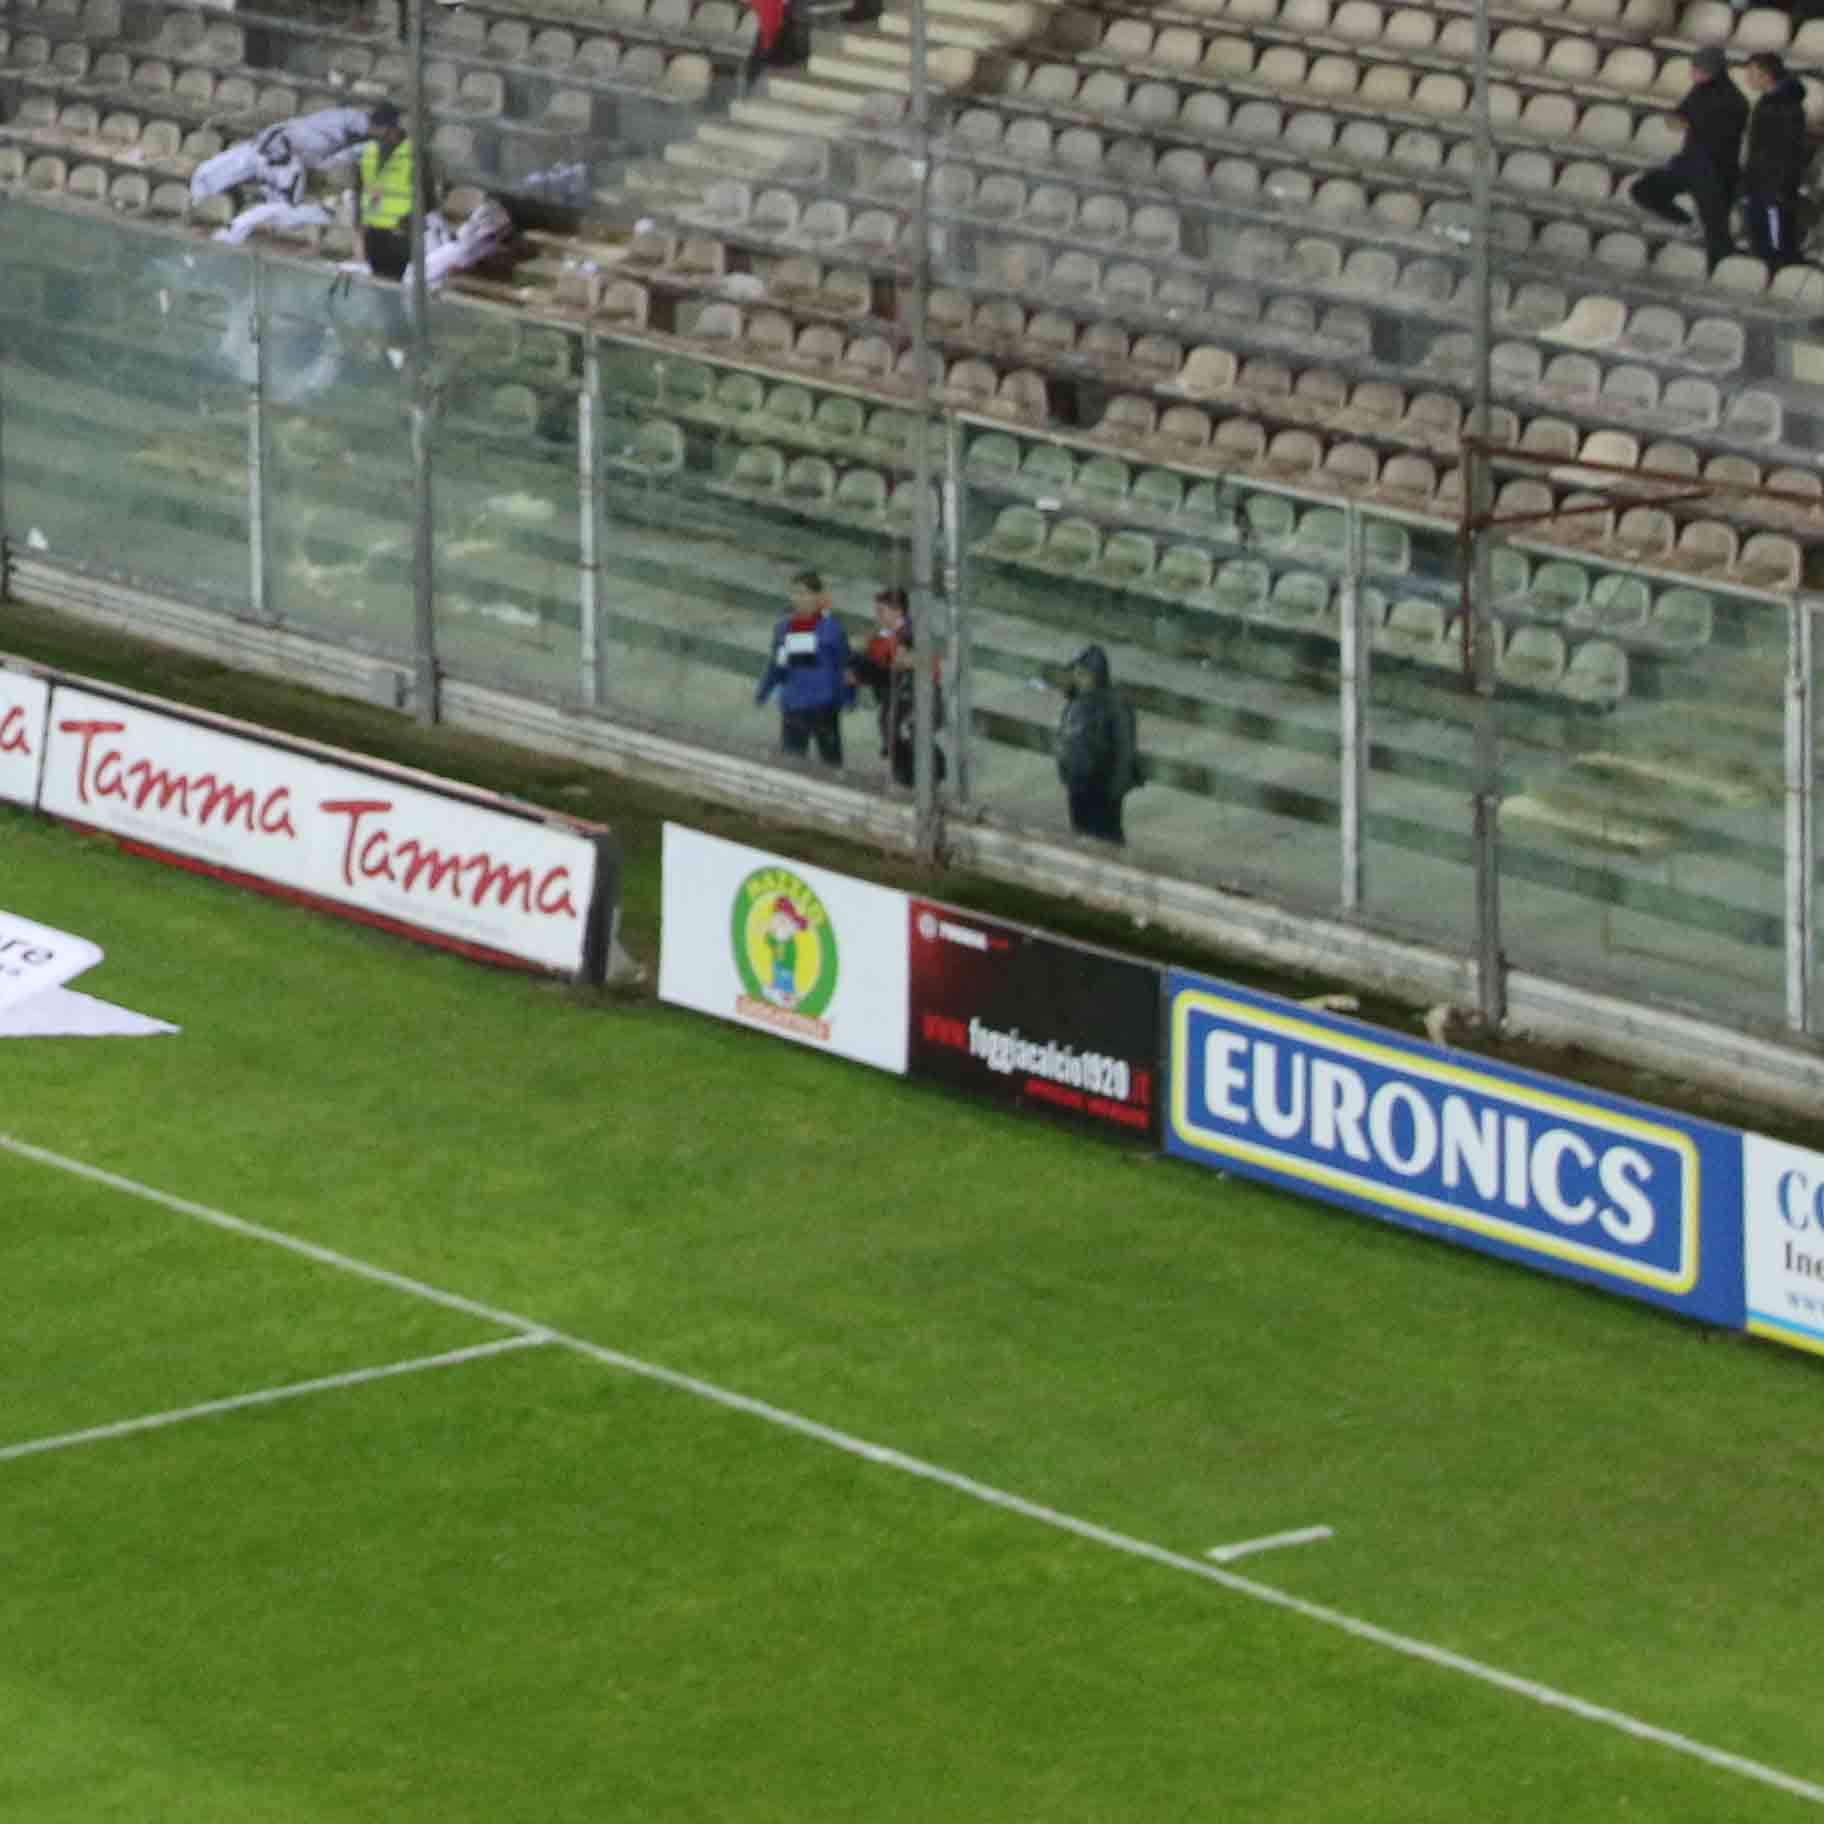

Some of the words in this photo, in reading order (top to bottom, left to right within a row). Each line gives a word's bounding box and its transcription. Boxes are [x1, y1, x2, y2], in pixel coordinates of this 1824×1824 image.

[61, 721, 296, 839] Tamma
[320, 800, 576, 918] Tamma
[1201, 1028, 1656, 1247] EURONICS
